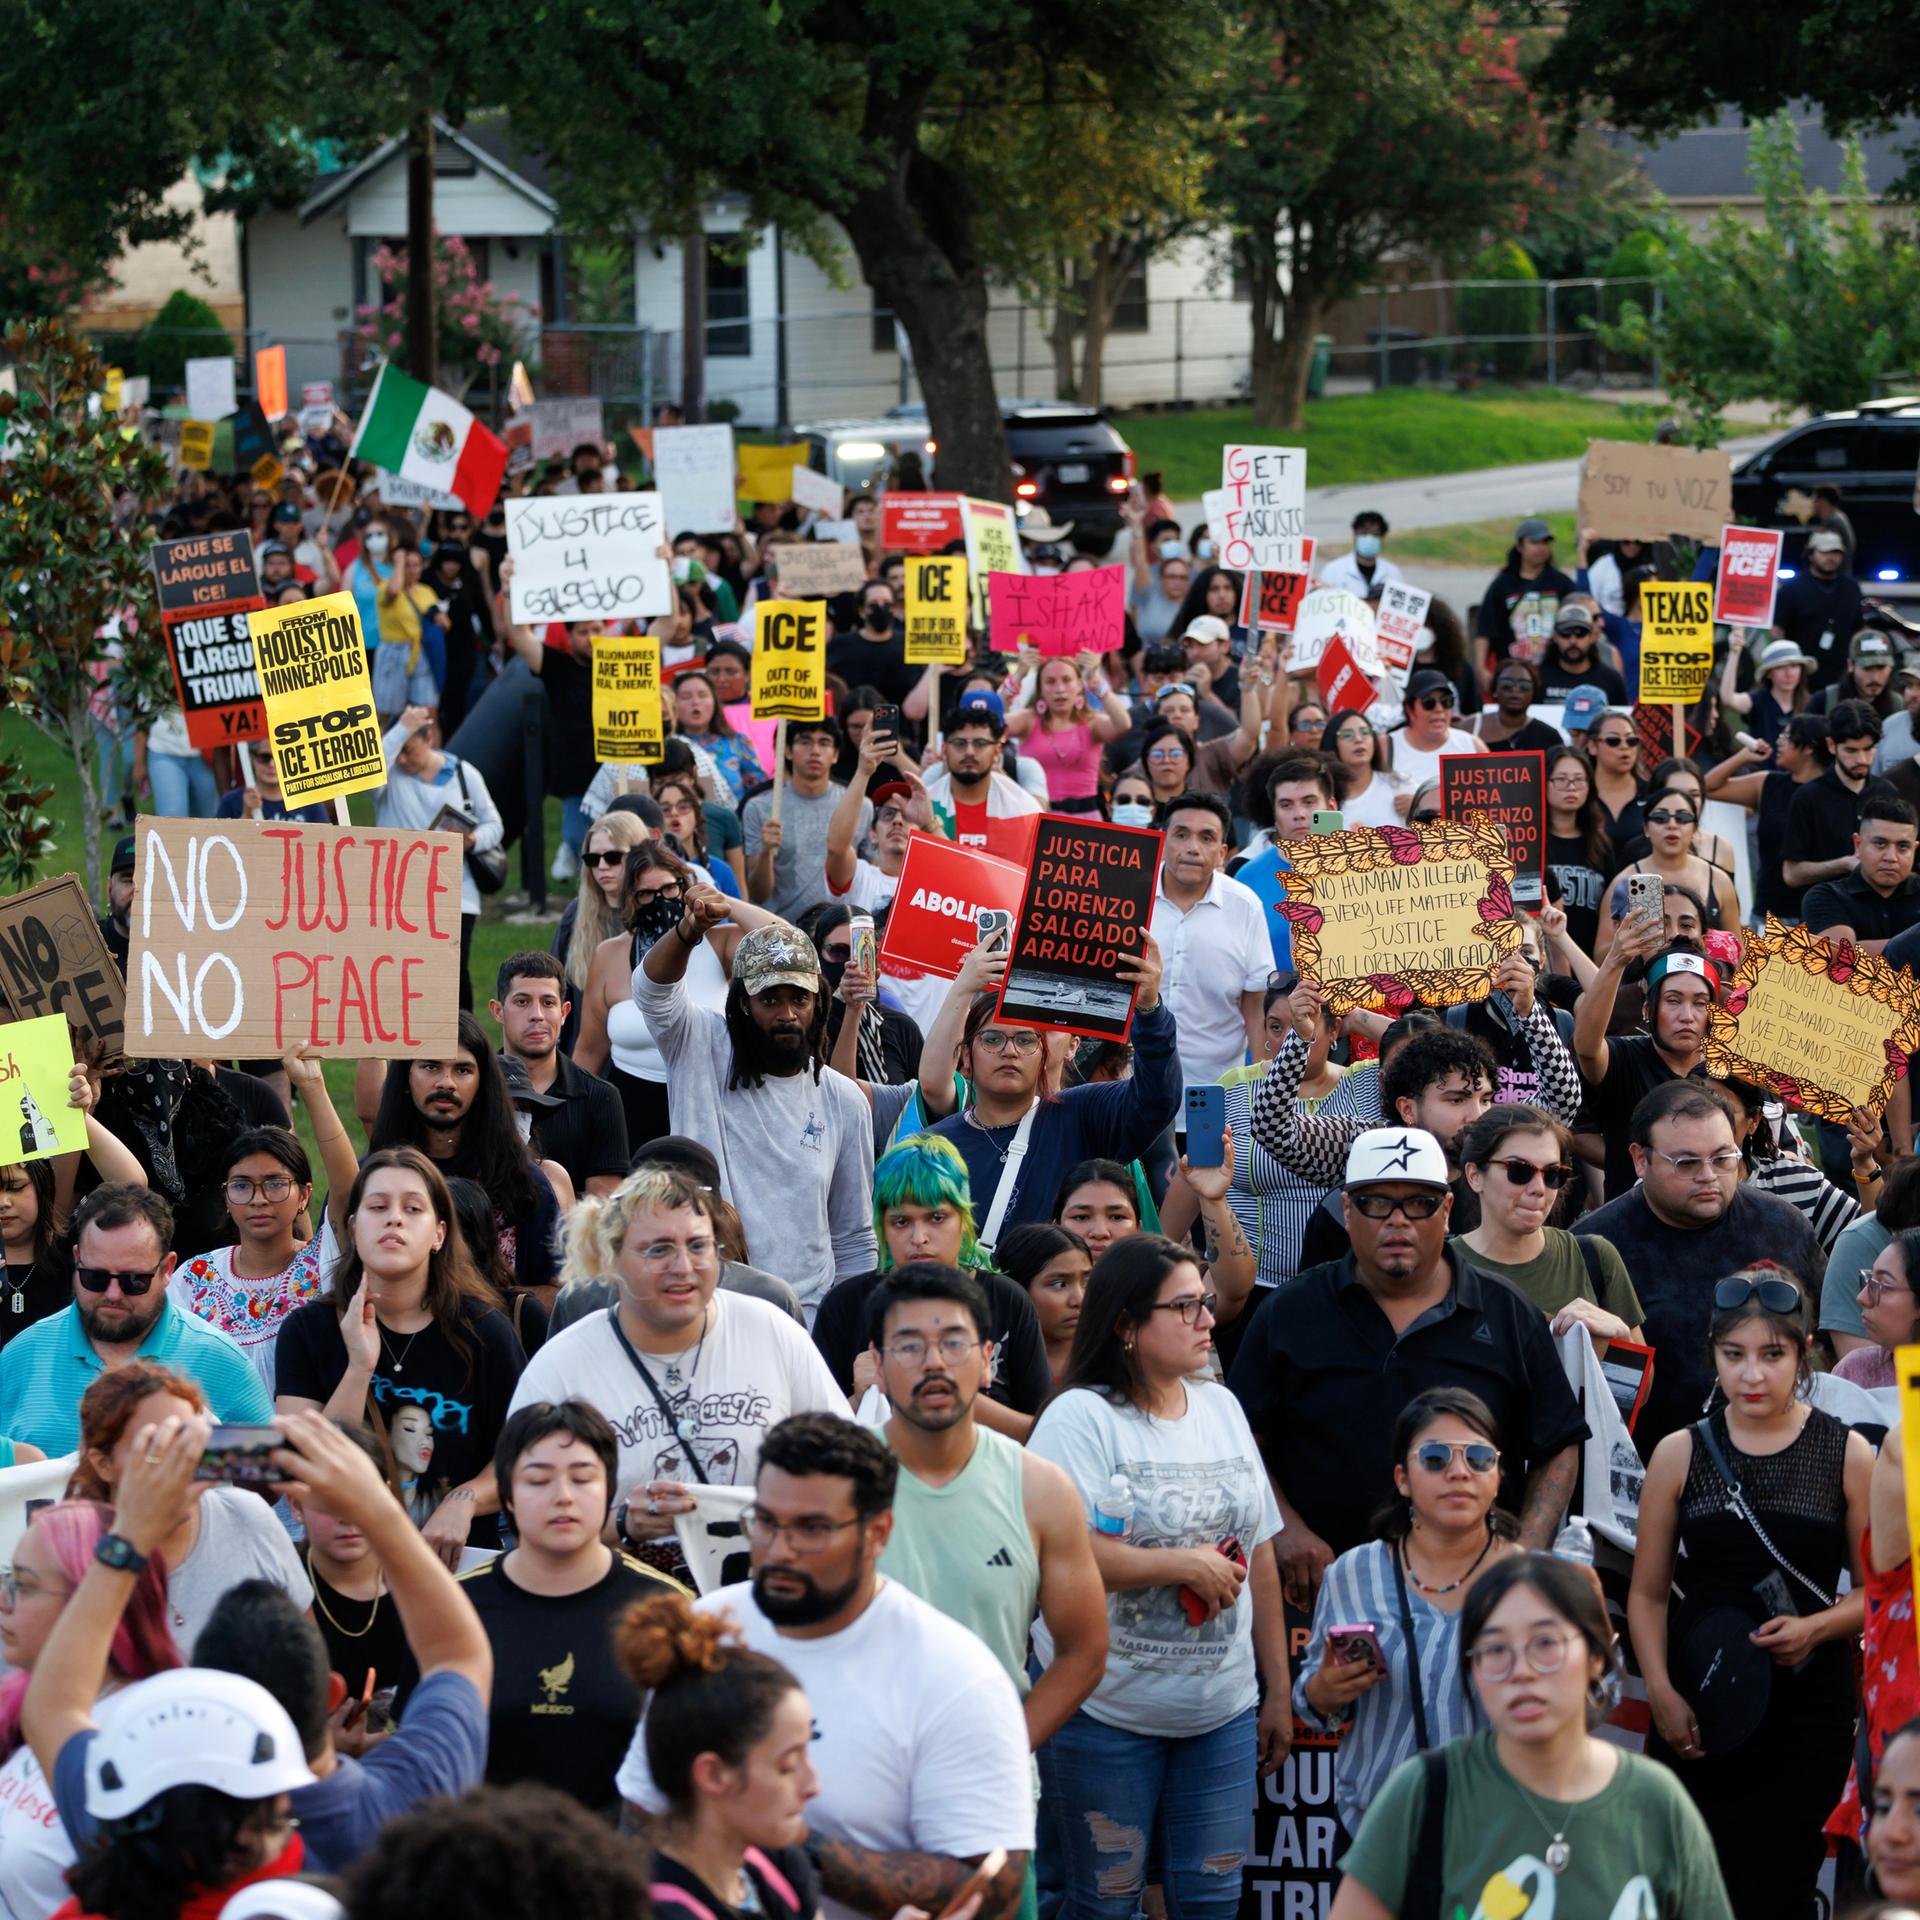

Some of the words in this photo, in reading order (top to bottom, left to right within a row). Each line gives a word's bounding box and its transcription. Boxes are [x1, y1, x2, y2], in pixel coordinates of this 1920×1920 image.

[1228, 448, 1291, 480] GET
[1227, 481, 1279, 507] THE
[1604, 474, 1632, 496] SOY
[1674, 480, 1718, 511] VOZ
[515, 501, 656, 550] JUSTICE
[1225, 508, 1303, 540] FASCISTS
[169, 540, 209, 562] ¡QUE
[212, 536, 234, 554] SE
[564, 549, 588, 571] 4
[1225, 539, 1293, 568] OUT!
[161, 560, 227, 586] LARGUE
[230, 558, 251, 575] EL
[1090, 570, 1120, 589] ON
[1727, 557, 1771, 577] ICE
[192, 584, 227, 603] ICE!
[918, 565, 953, 602] ICE
[1260, 593, 1289, 615] ICE
[1644, 592, 1709, 624] TEXAS
[173, 616, 226, 651] ¡QUE
[231, 612, 250, 639] S
[281, 612, 326, 630] FROM
[763, 613, 817, 652] ICE
[912, 617, 927, 630] OUT
[929, 618, 939, 630] OF
[941, 617, 955, 630] OUR
[256, 614, 359, 670] HOUSTON
[909, 633, 960, 646] COMMUNITIES
[1059, 626, 1120, 655] LAND
[178, 641, 253, 678] LARGU
[302, 651, 323, 664] TO
[598, 662, 619, 677] ARE
[625, 662, 653, 677] THE
[1643, 652, 1710, 665] STOP
[187, 670, 261, 704] TRUM
[263, 650, 363, 697] MINNEAPOLIS
[767, 667, 790, 681] OUT
[795, 669, 811, 681] OF
[1643, 667, 1661, 685] ICE
[760, 685, 817, 700] HOUSTON
[220, 709, 258, 735] YA!
[274, 703, 372, 745] STOP
[608, 710, 639, 727] NOT
[277, 745, 309, 779] ICE
[308, 727, 379, 770] TERROR
[343, 769, 351, 778] &
[1450, 768, 1531, 786] JUSTICIA
[1450, 789, 1502, 805] PARA
[1450, 807, 1533, 825] LOENZO
[1042, 836, 1142, 870] JUSTICIA
[142, 829, 248, 938] NO
[261, 829, 450, 940] JUSTICE
[1038, 861, 1100, 890] PARA
[1312, 878, 1336, 901] NO
[1342, 870, 1401, 899] HUMAN
[1407, 864, 1421, 889] IS
[1423, 862, 1486, 887] ILLEGAL
[1033, 887, 1136, 920] LORENZO
[1377, 899, 1406, 916] LIFE
[1028, 912, 1137, 946] SALGADO
[1360, 919, 1447, 950] JUSTICE
[0, 915, 59, 996] NO
[1021, 937, 1118, 969] ARAUJO
[1319, 956, 1356, 979] FOR
[1355, 951, 1429, 976] LORENZO
[1432, 942, 1500, 970] SALGADO
[1765, 960, 1820, 1001] ENOUGH
[1823, 984, 1835, 1005] IS
[142, 950, 244, 1039] NO
[272, 951, 424, 1049] PEACE
[1749, 990, 1773, 1014] WE
[1779, 999, 1835, 1036] DEMAND
[1837, 1022, 1878, 1054] TRUTH
[1734, 1034, 1761, 1059] RIP
[1761, 1046, 1810, 1079] LORENZO
[1751, 1016, 1773, 1040] WE
[1779, 1026, 1831, 1064] DEMAND
[1832, 1049, 1885, 1081] JUSTICE
[1117, 1638, 1168, 1656] NASSAU
